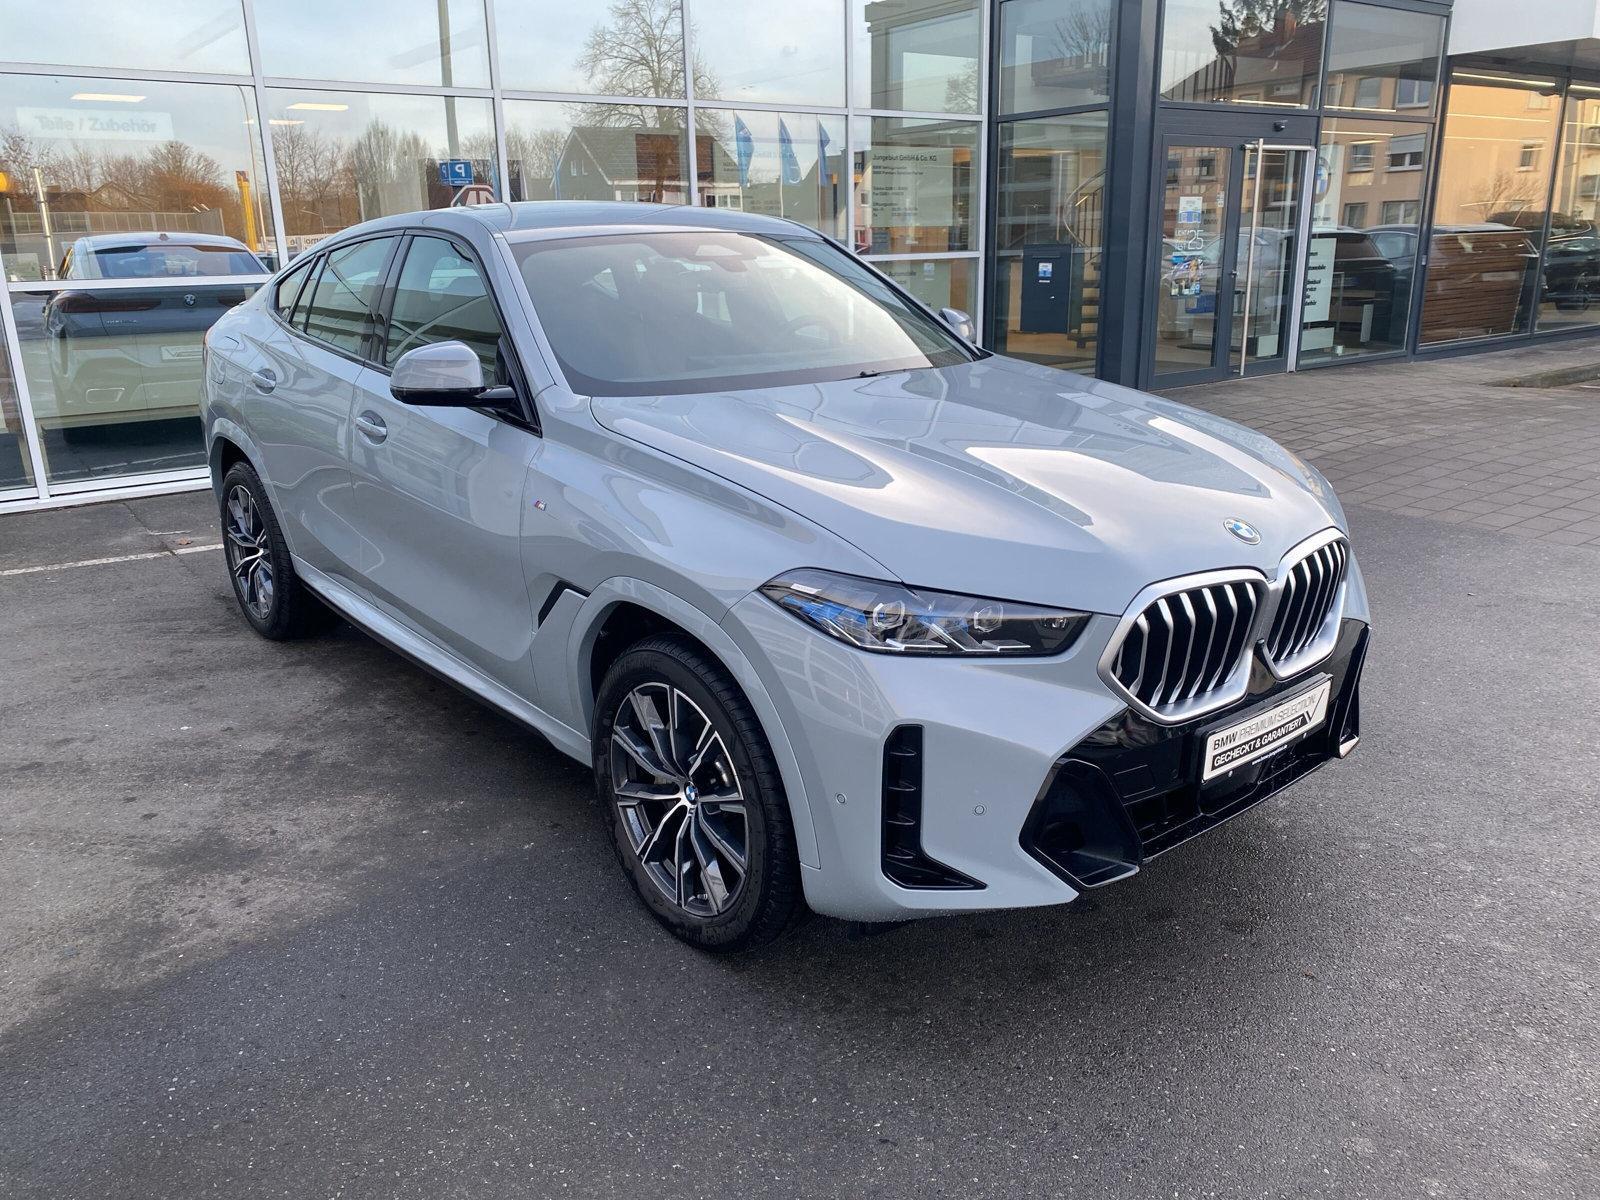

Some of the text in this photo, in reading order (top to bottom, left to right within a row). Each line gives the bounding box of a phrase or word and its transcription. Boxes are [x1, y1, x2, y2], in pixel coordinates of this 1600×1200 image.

[34, 115, 74, 131] Teile
[88, 117, 157, 133] Zubehör
[1214, 694, 1316, 750] BMW PREMIUM SELECTION
[1214, 741, 1256, 767] GECHECKT
[1255, 738, 1261, 748] &
[1261, 716, 1304, 745] GARANTIERT
